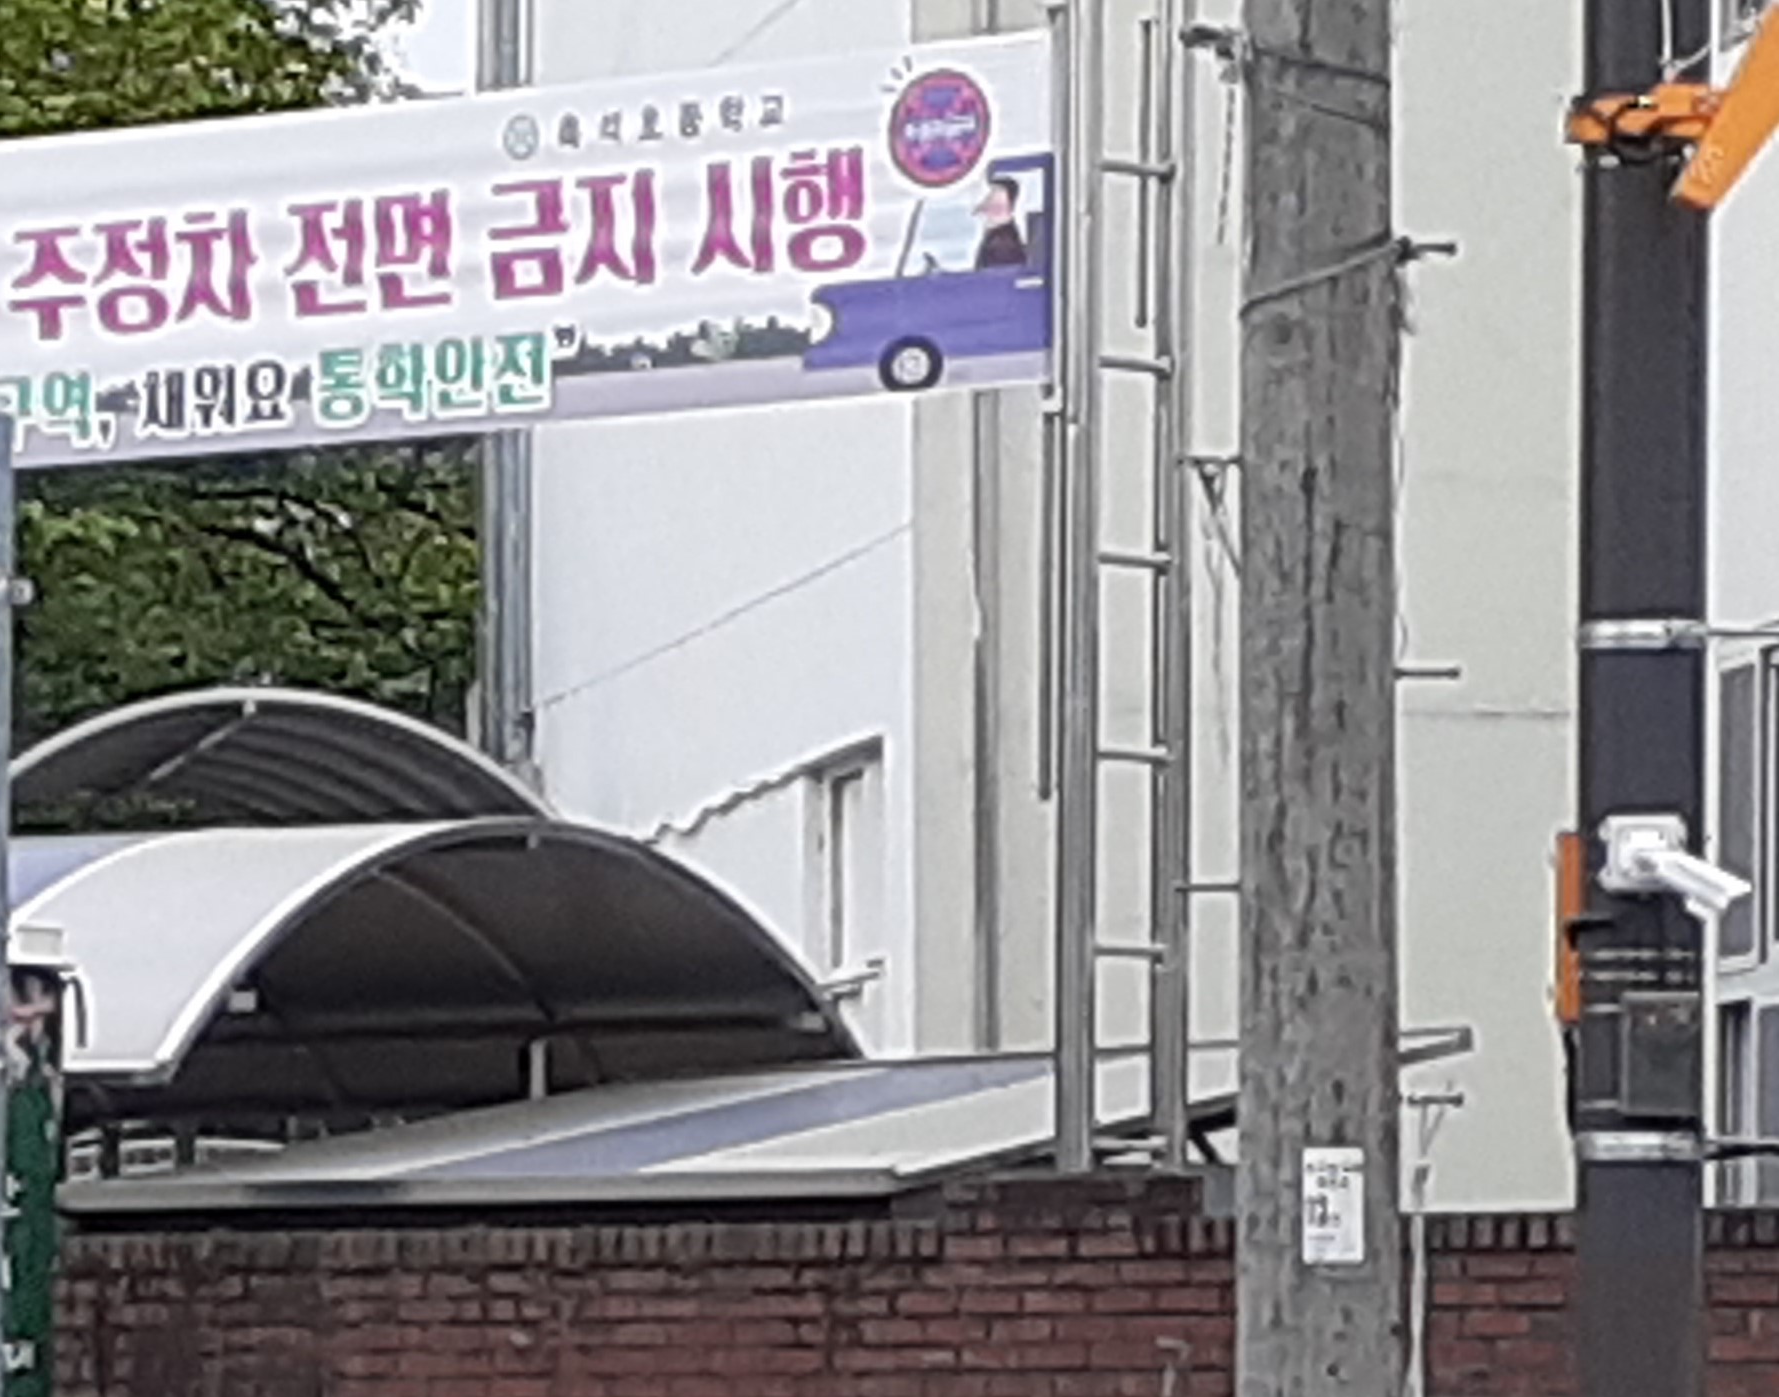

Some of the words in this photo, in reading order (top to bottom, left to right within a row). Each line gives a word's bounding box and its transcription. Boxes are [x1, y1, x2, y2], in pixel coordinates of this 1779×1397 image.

[8, 204, 258, 341] 주정차
[285, 190, 453, 319] 전면
[487, 162, 657, 300] 금지
[690, 146, 869, 280] 시행
